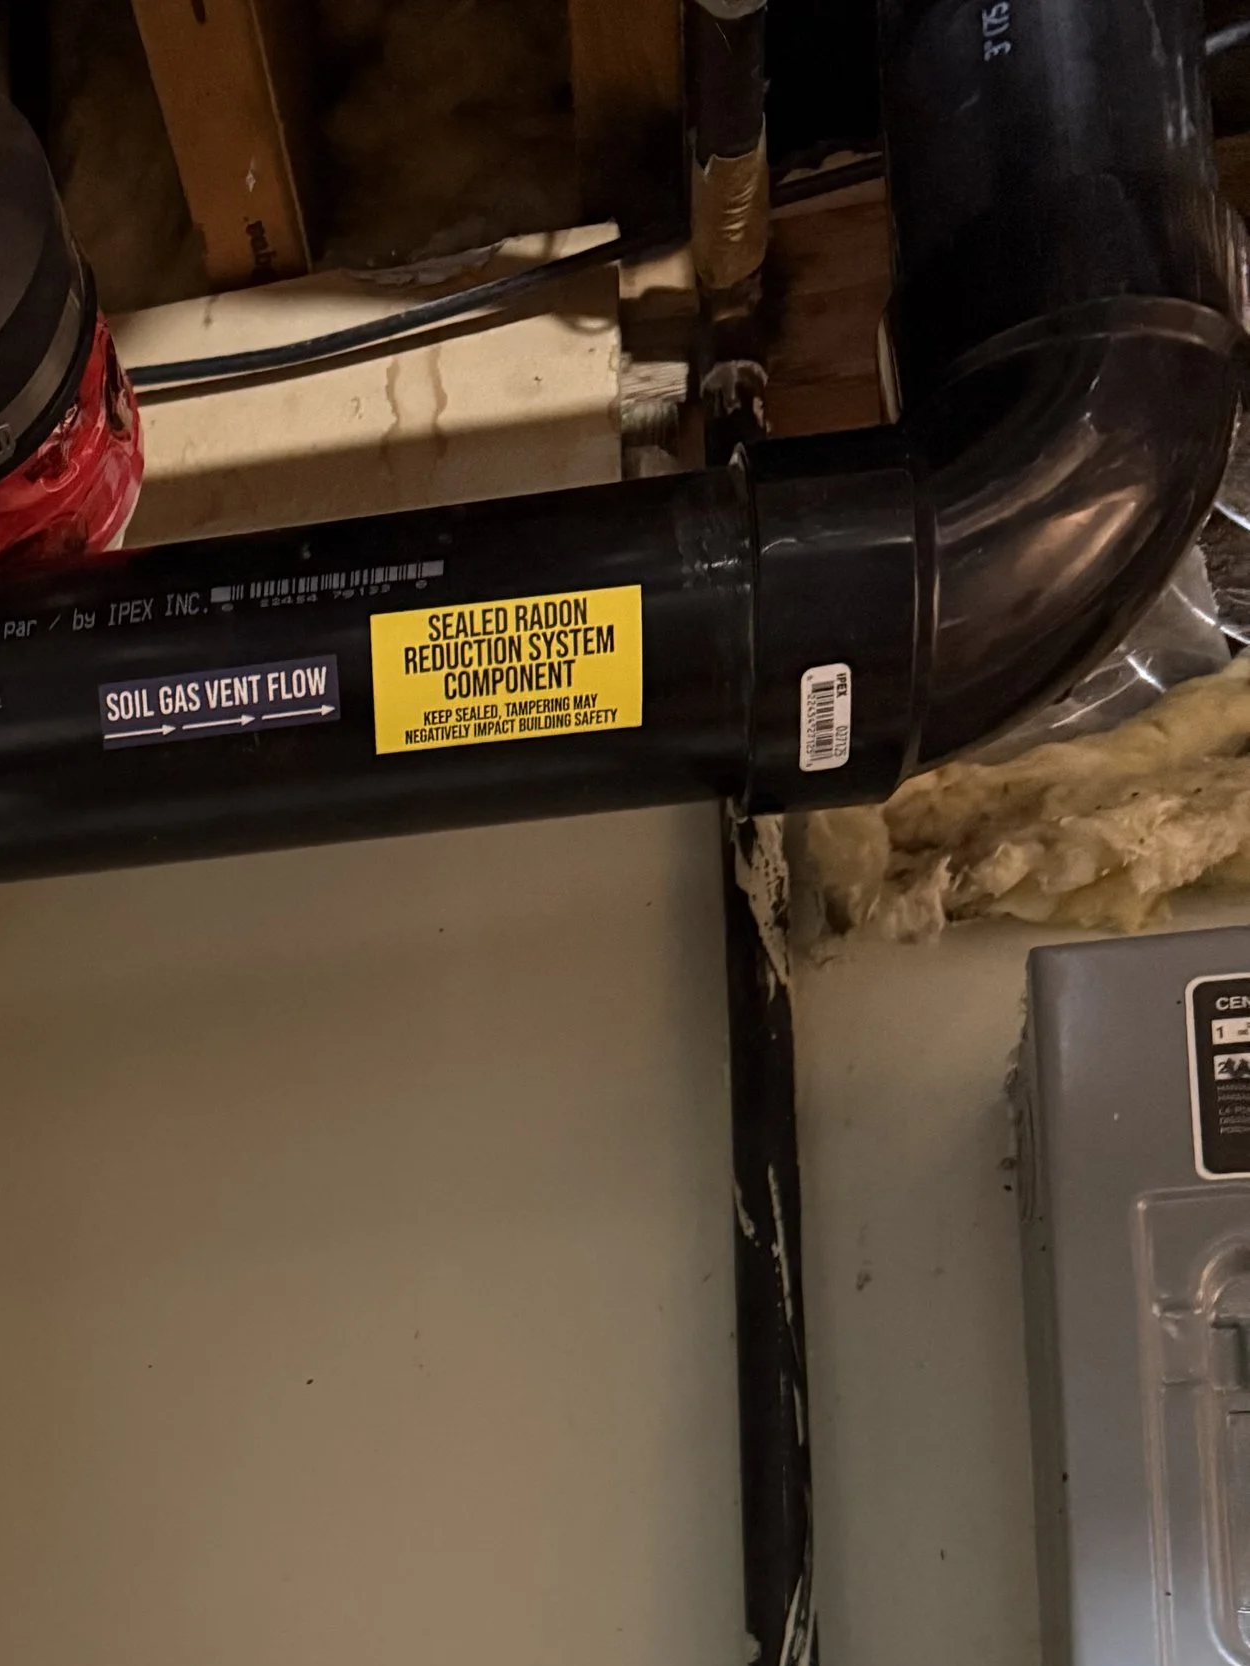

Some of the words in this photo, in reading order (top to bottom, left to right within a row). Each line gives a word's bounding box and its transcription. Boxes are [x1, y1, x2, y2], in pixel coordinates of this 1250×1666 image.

[3, 618, 37, 640] par
[49, 614, 61, 631] /
[72, 608, 96, 631] by
[108, 596, 153, 626] IPEX
[165, 592, 210, 618] INC.
[428, 607, 508, 642] SEALED
[515, 598, 587, 632] RADON
[404, 636, 522, 675] REDUCTION
[529, 624, 615, 662] SYSTEM
[106, 687, 154, 722] SOIL
[159, 682, 201, 716] GAS
[205, 674, 261, 710] VENT
[267, 666, 327, 702] FLOW
[444, 659, 576, 700] COMPONENT
[836, 672, 848, 698] IPEX
[405, 724, 471, 745] NEGATIVELY
[474, 718, 515, 738] IMPACT
[519, 713, 572, 733] BUILDING
[575, 708, 618, 727] SAFETY
[423, 710, 452, 727] KEEP
[455, 705, 502, 722] SEALED,
[505, 696, 571, 718] TAMPERING
[573, 693, 599, 711] MAY
